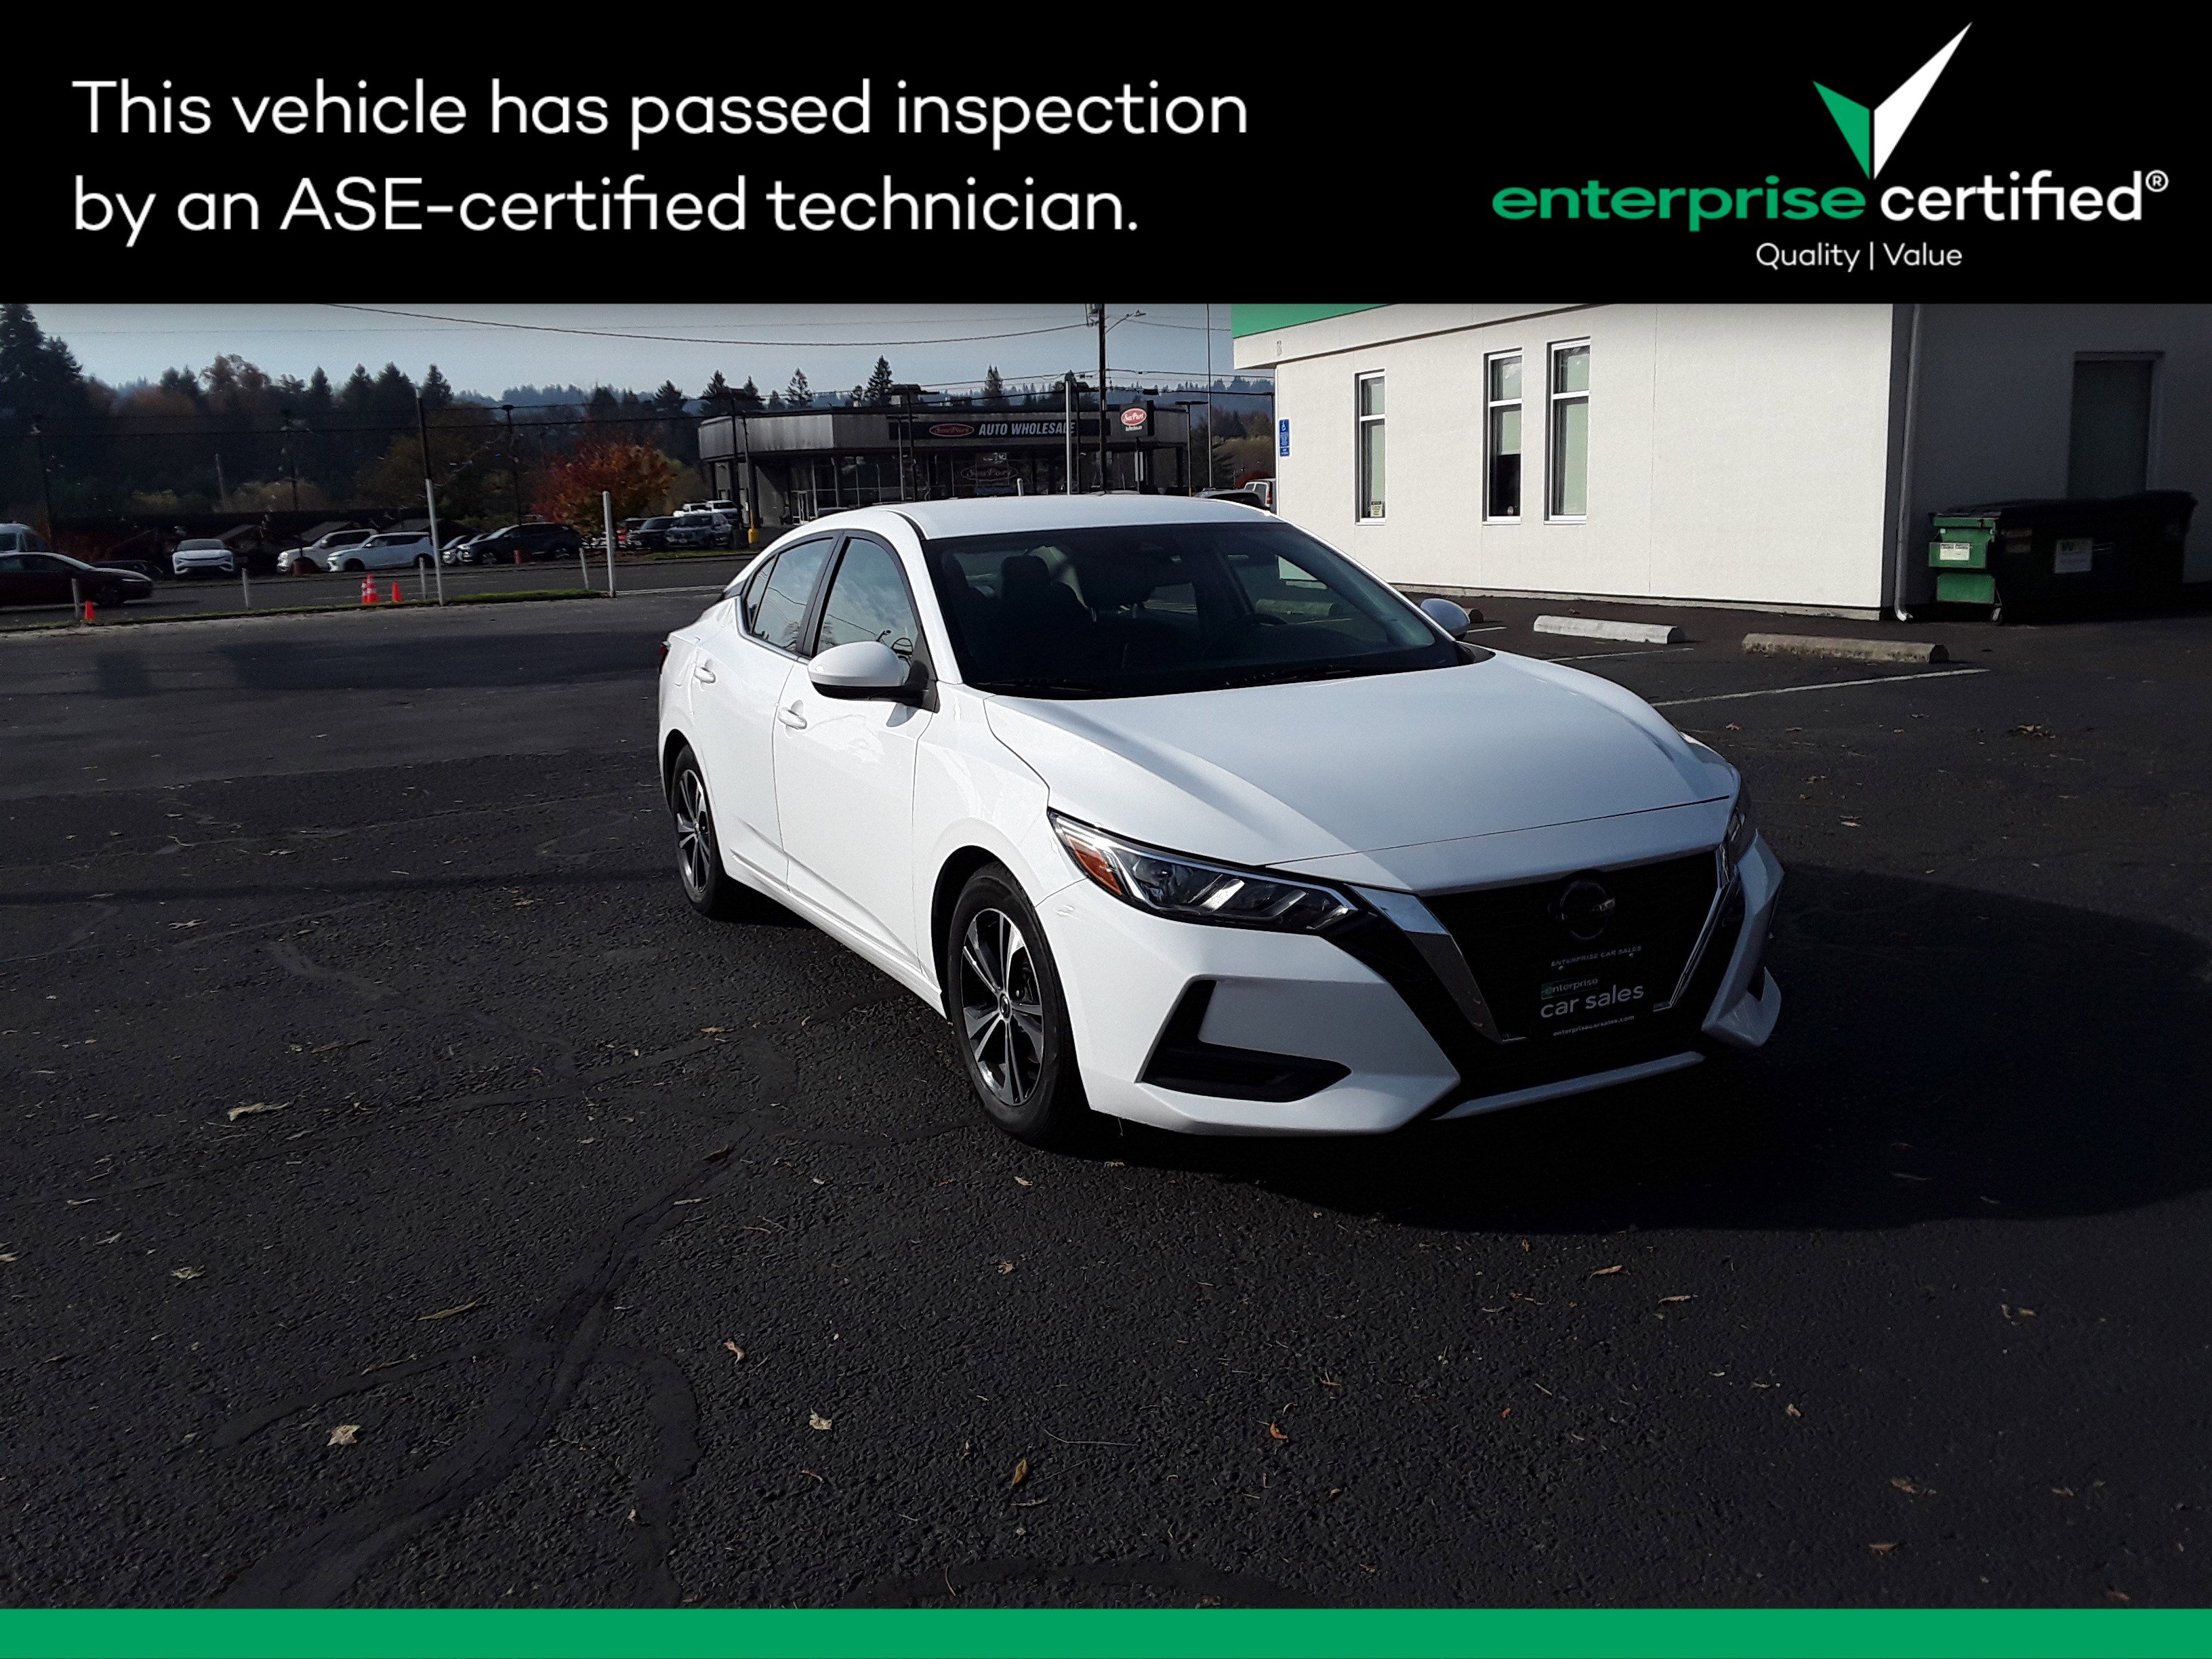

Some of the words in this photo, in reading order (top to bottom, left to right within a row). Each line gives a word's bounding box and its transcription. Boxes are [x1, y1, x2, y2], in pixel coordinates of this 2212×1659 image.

[978, 424, 1008, 436] AUTO
[1011, 422, 1076, 435] WHOLESALE
[1601, 949, 1616, 958] CAR
[1540, 998, 1579, 1019] car
[1584, 984, 1644, 1010] sales
